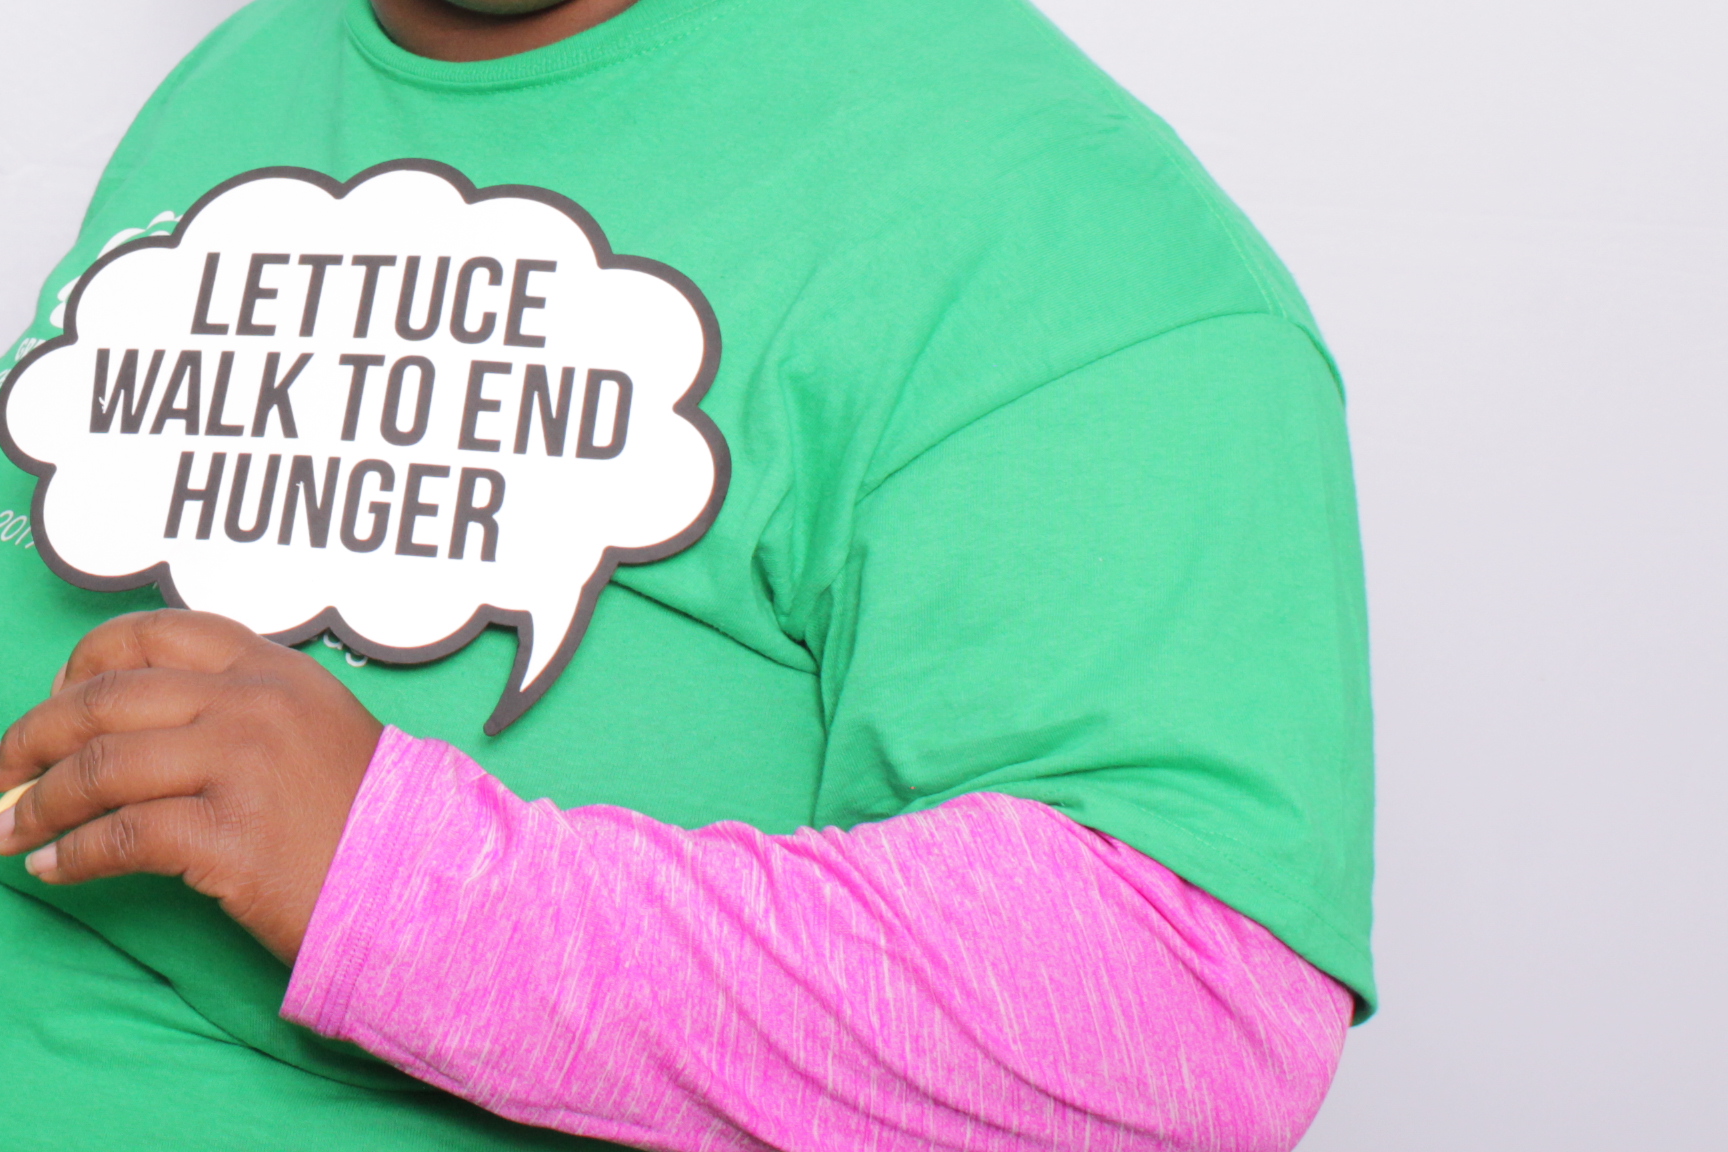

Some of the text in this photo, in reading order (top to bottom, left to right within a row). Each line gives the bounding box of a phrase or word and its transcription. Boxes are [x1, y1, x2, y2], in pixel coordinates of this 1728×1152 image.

[190, 251, 558, 349] LETTUCE
[88, 347, 635, 461] WALK TO END
[162, 450, 507, 564] HUNGER
